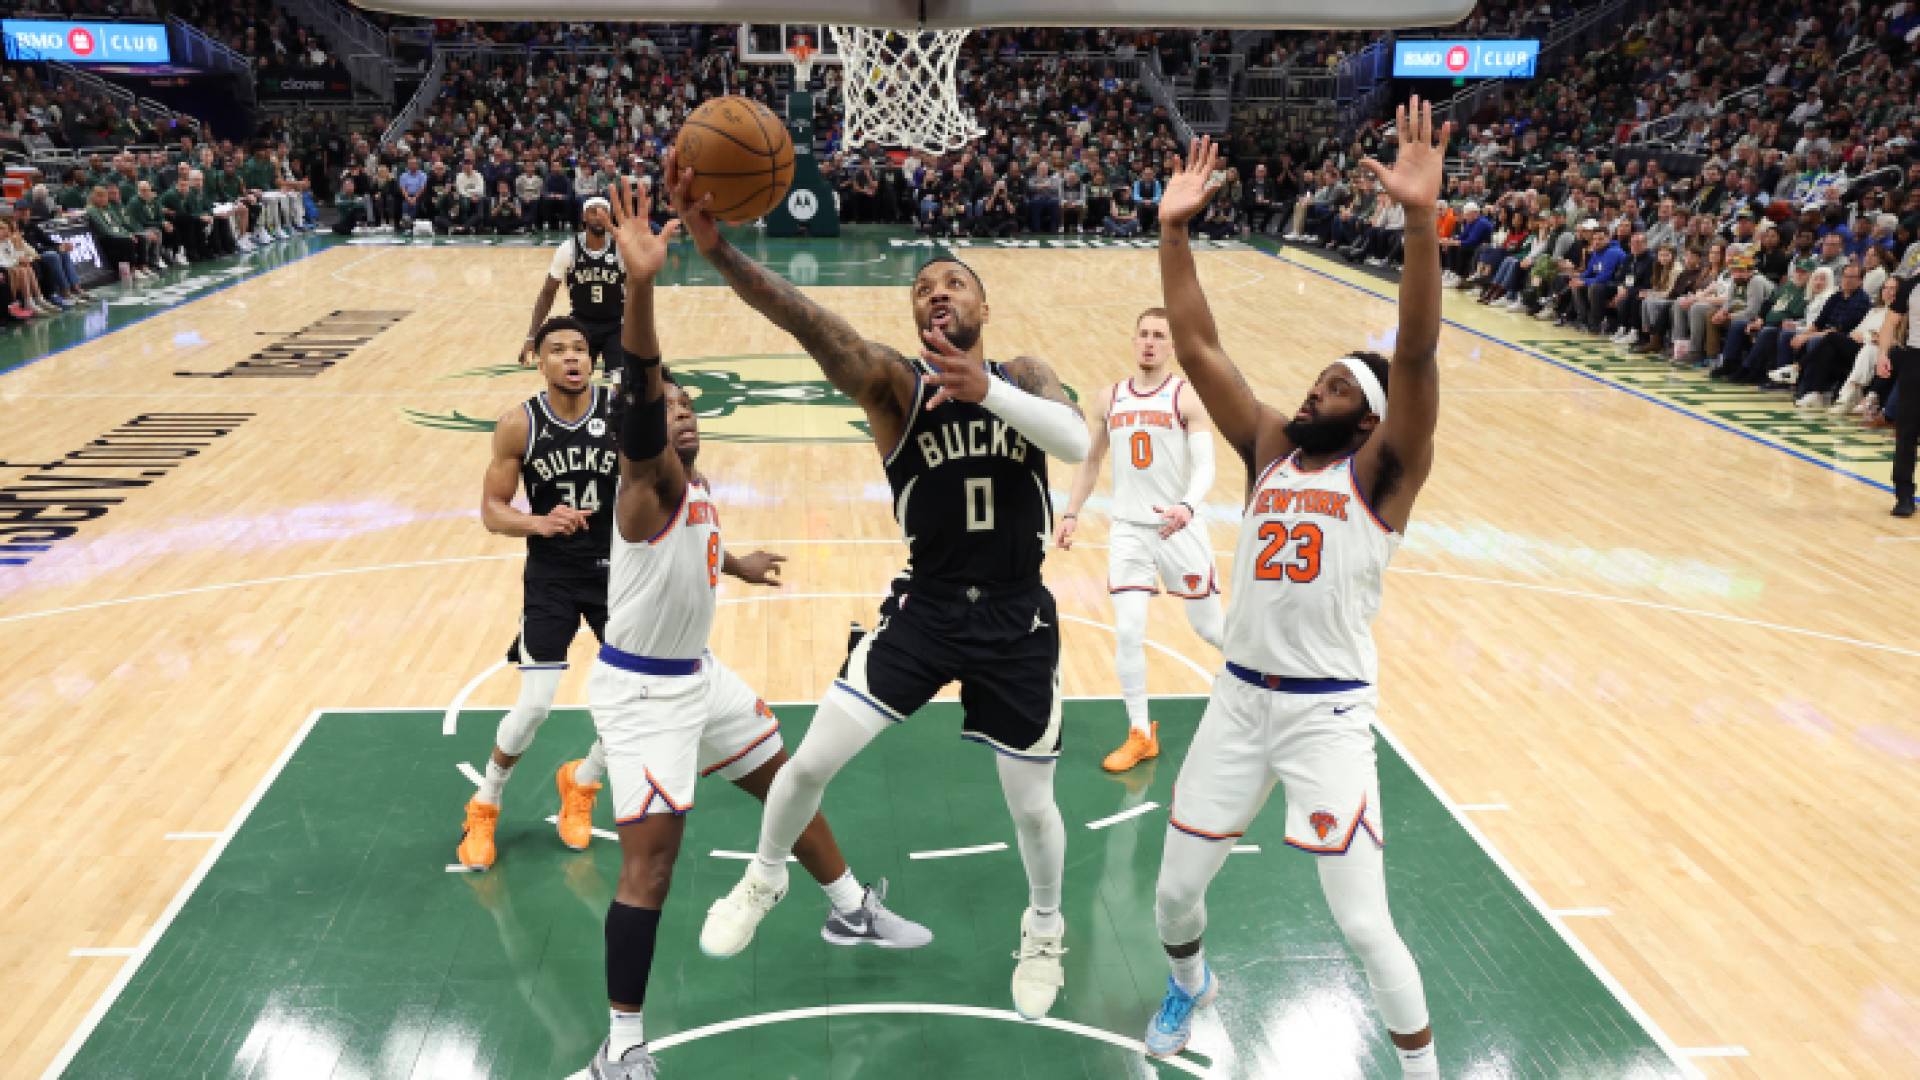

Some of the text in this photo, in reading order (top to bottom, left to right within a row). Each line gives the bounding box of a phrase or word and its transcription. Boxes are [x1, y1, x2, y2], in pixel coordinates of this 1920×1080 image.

[16, 31, 158, 52] BMO CLUB
[1403, 51, 1442, 66] BMO
[574, 267, 620, 284] BUCKS
[917, 420, 1028, 469] BUCKS
[1130, 431, 1153, 470] 0
[532, 447, 617, 481] BUCKS
[555, 480, 601, 513] 34
[964, 477, 995, 532] 0
[1290, 488, 1350, 521] YORK
[1255, 520, 1324, 583] 23
